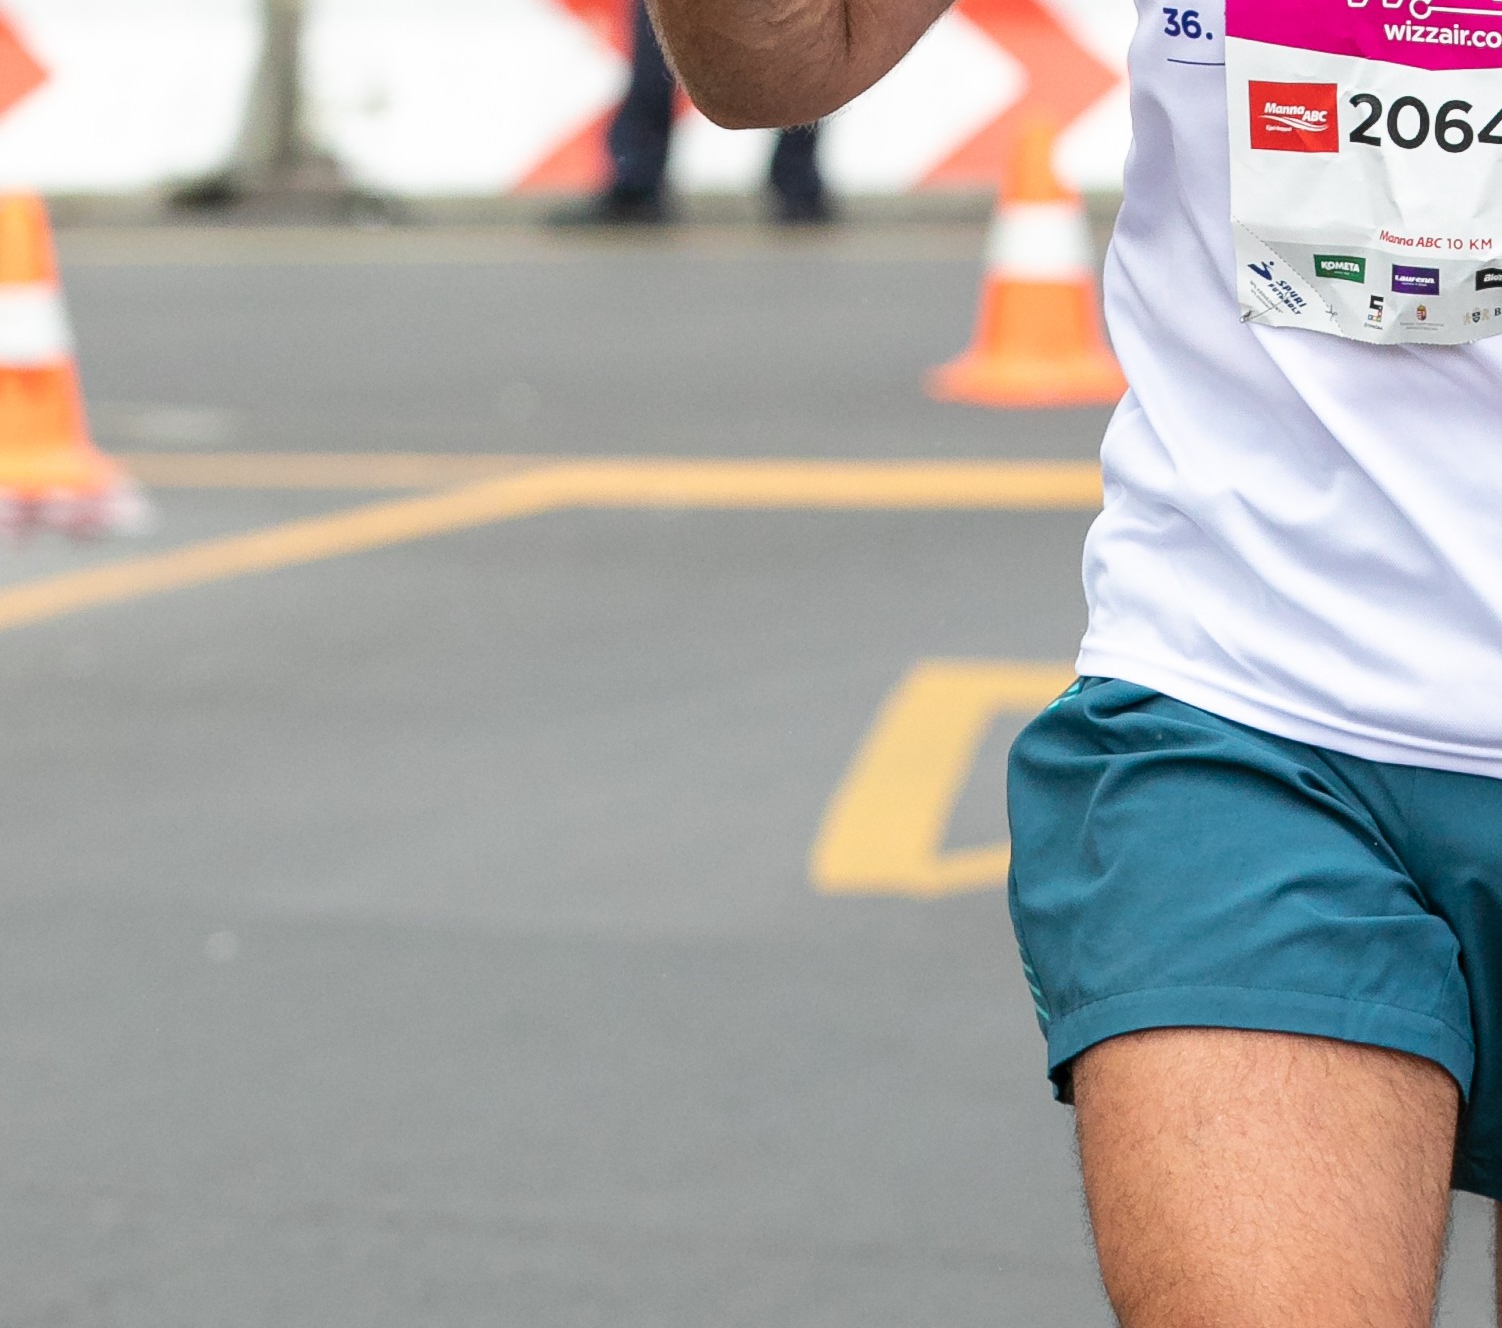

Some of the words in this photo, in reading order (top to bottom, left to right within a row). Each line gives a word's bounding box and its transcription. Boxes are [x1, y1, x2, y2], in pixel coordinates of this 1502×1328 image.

[1162, 7, 1213, 41] 36.
[1263, 102, 1305, 115] Manna
[1302, 110, 1328, 122] ABC
[1379, 230, 1414, 247] Manna
[1416, 236, 1443, 249] ABC
[1447, 238, 1464, 250] 10
[1320, 261, 1361, 273] KOMETA
[1275, 280, 1307, 308] SPURI
